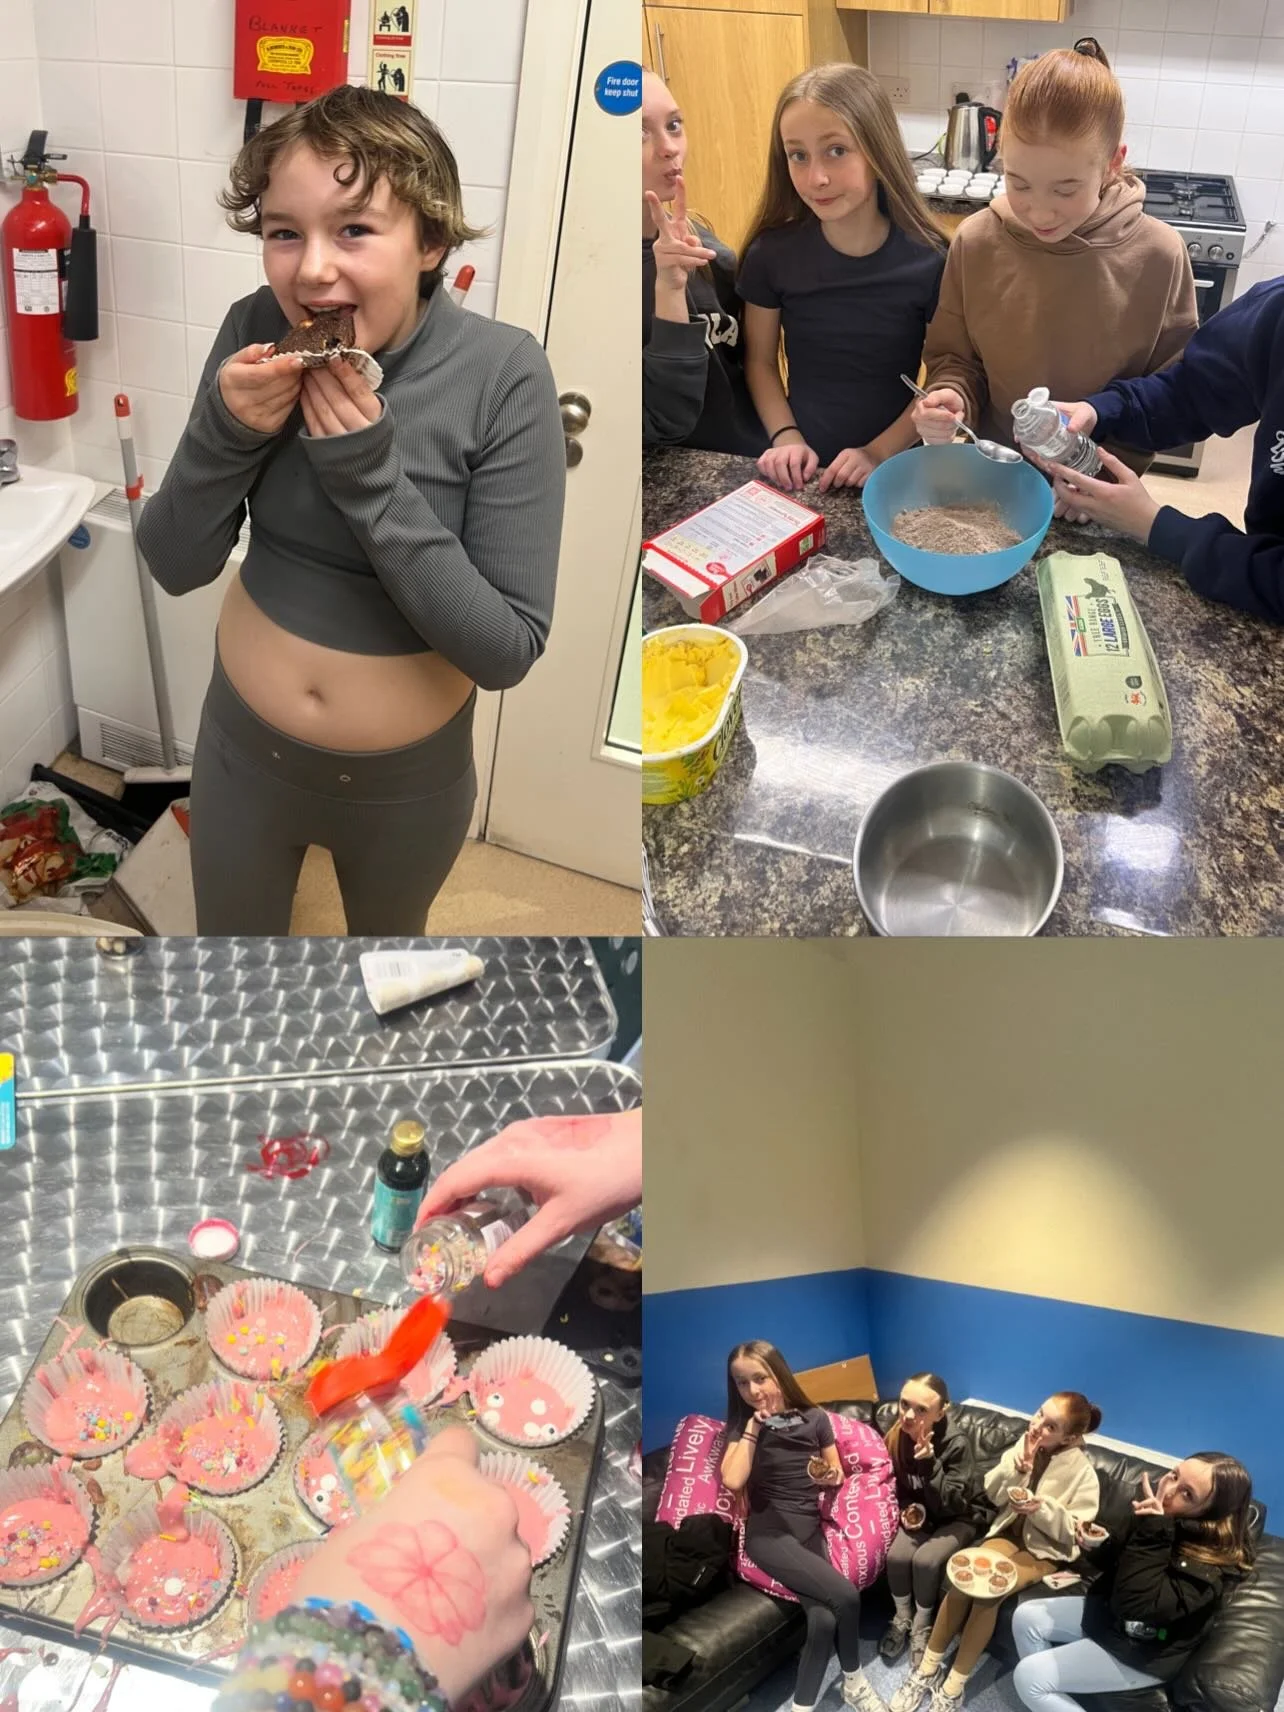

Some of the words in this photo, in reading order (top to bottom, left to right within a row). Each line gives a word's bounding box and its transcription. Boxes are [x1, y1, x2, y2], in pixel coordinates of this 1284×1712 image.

[248, 14, 324, 34] BLANKET
[606, 76, 621, 86] Fire
[622, 77, 640, 86] door
[604, 87, 622, 99] keep
[622, 87, 639, 97] shut
[1095, 598, 1113, 619] EGGS
[1100, 618, 1119, 642] LARGE
[1105, 641, 1120, 653] 12
[675, 1416, 714, 1474] Lively
